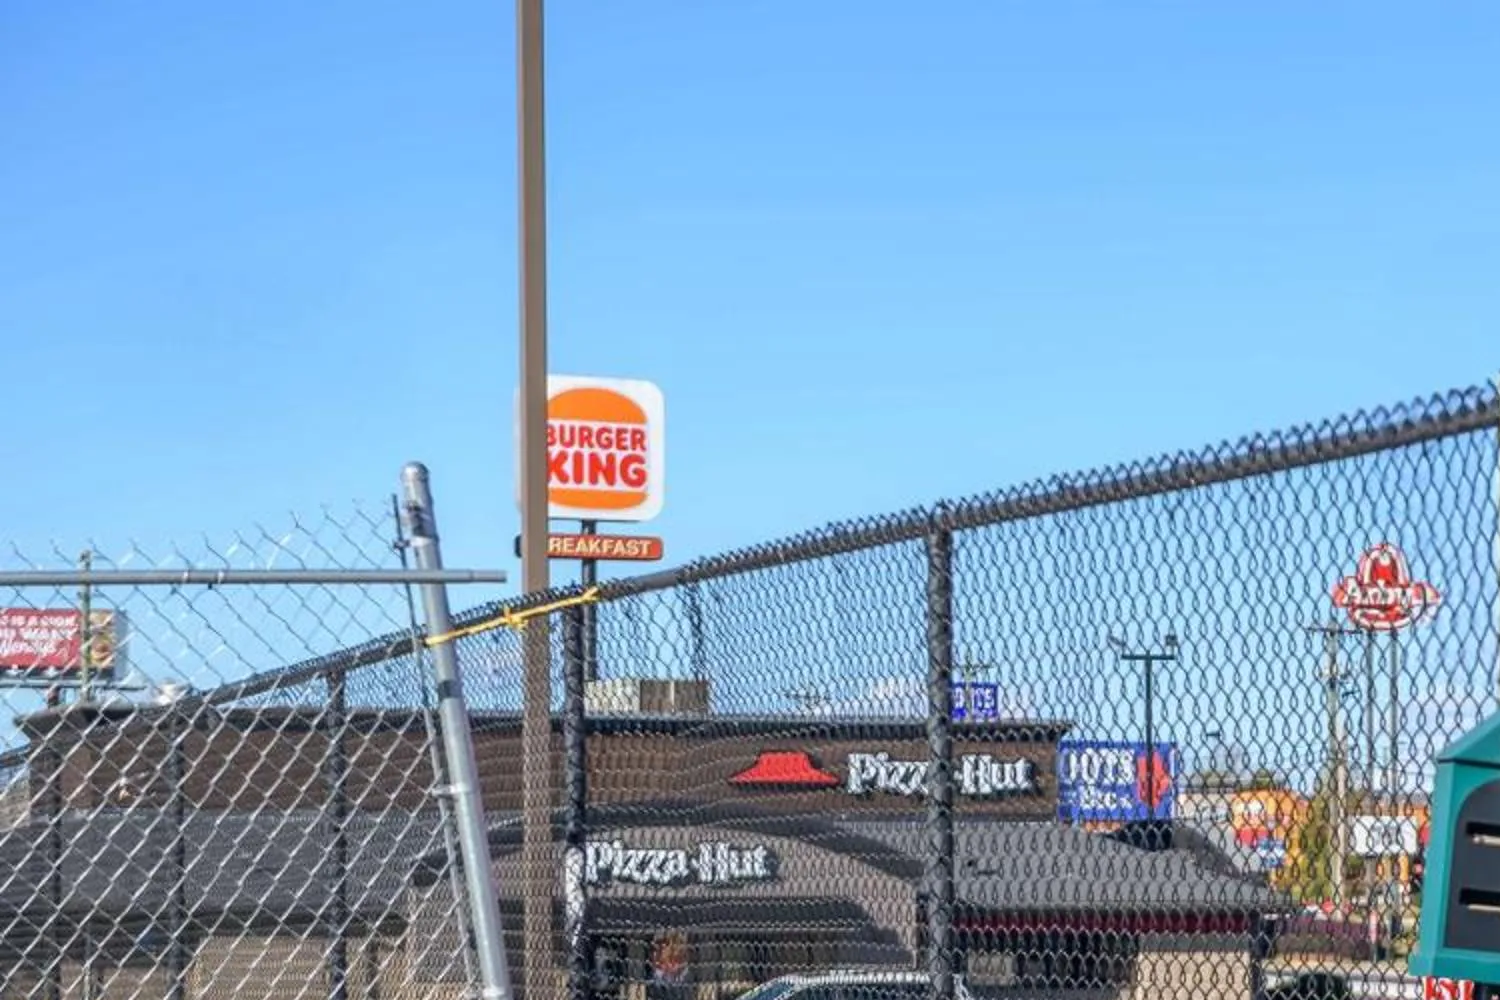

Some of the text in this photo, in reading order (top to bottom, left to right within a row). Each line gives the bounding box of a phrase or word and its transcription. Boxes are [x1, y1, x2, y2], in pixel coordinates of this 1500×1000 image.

[547, 451, 648, 488] KING
[549, 536, 652, 556] REAKFAST
[848, 752, 1033, 795] Pizz Hut
[585, 840, 772, 884] Pizza Hut
